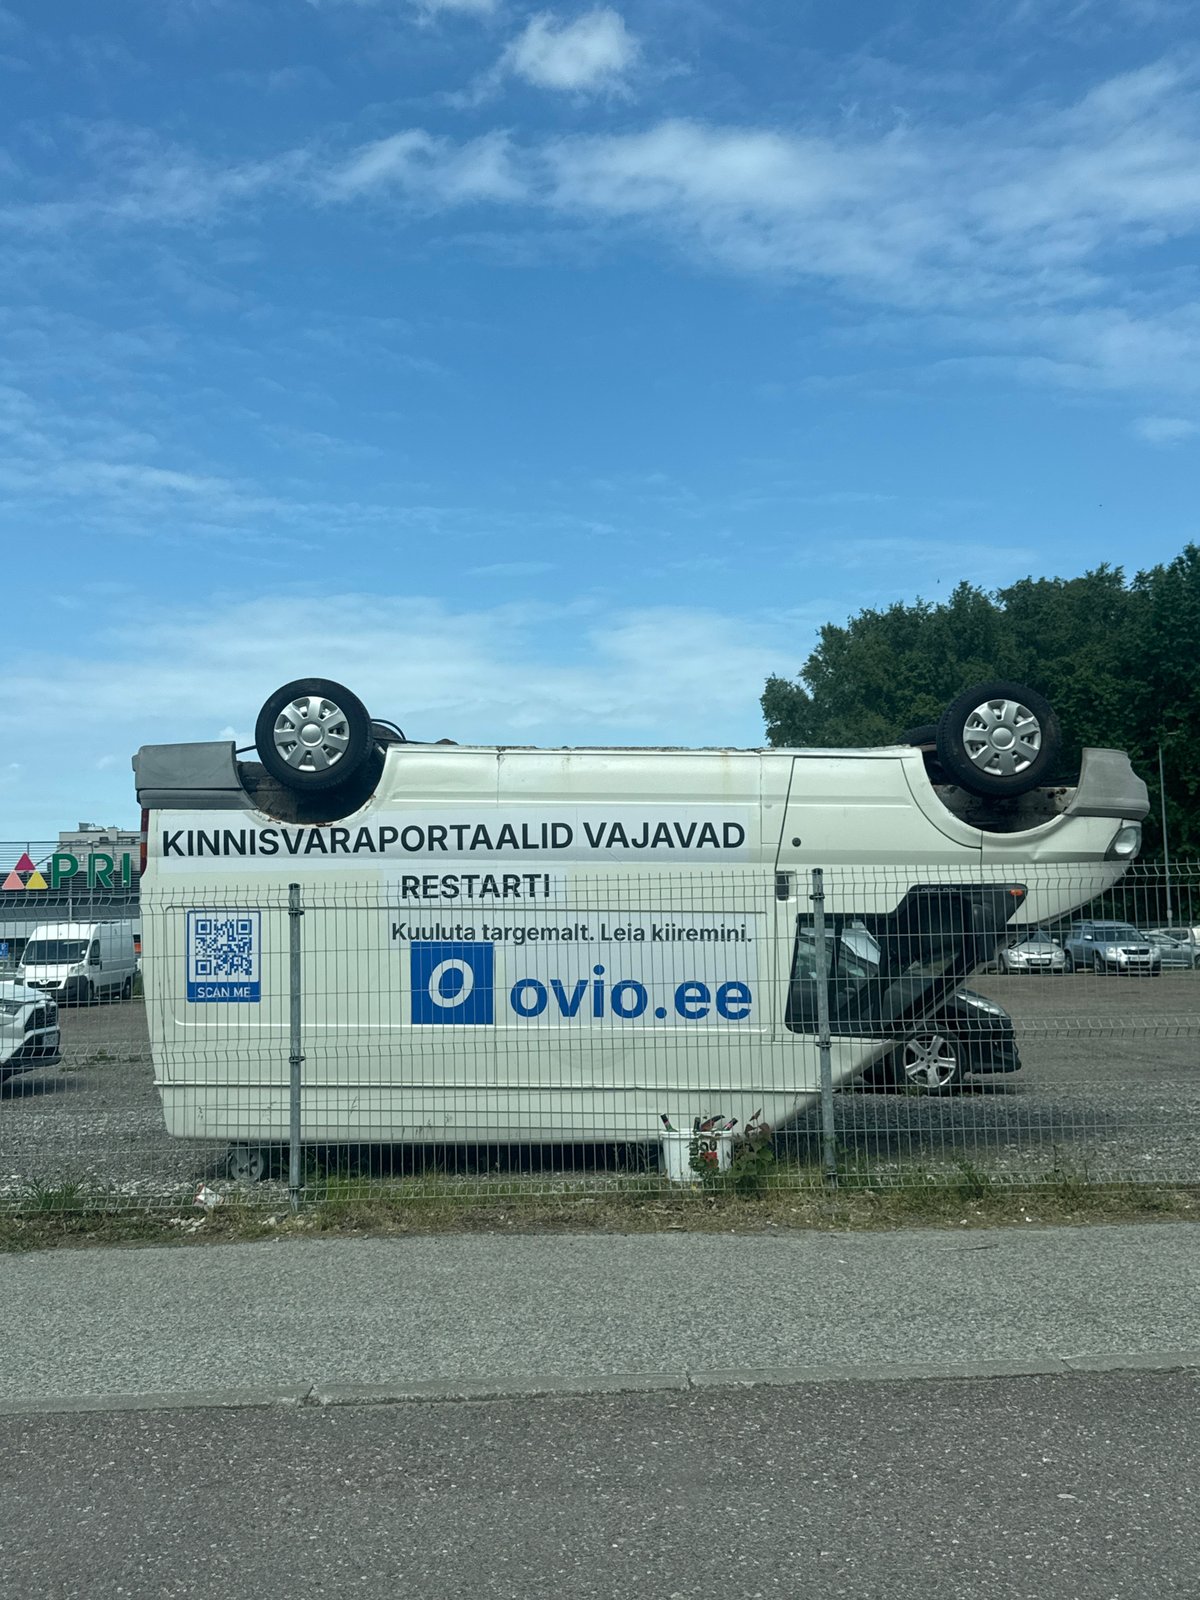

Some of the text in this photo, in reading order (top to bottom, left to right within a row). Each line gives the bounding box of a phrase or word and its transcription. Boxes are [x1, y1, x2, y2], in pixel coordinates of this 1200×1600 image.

[163, 822, 745, 856] KINNISVARAPORTAALID VAJAVAD
[51, 853, 131, 889] PRI
[402, 874, 550, 899] RESTARTI
[392, 922, 752, 945] Kuuluta targemalt. Leia kiiremini.
[197, 986, 251, 998] SCAN ME
[510, 964, 752, 1020] ovio.ee
